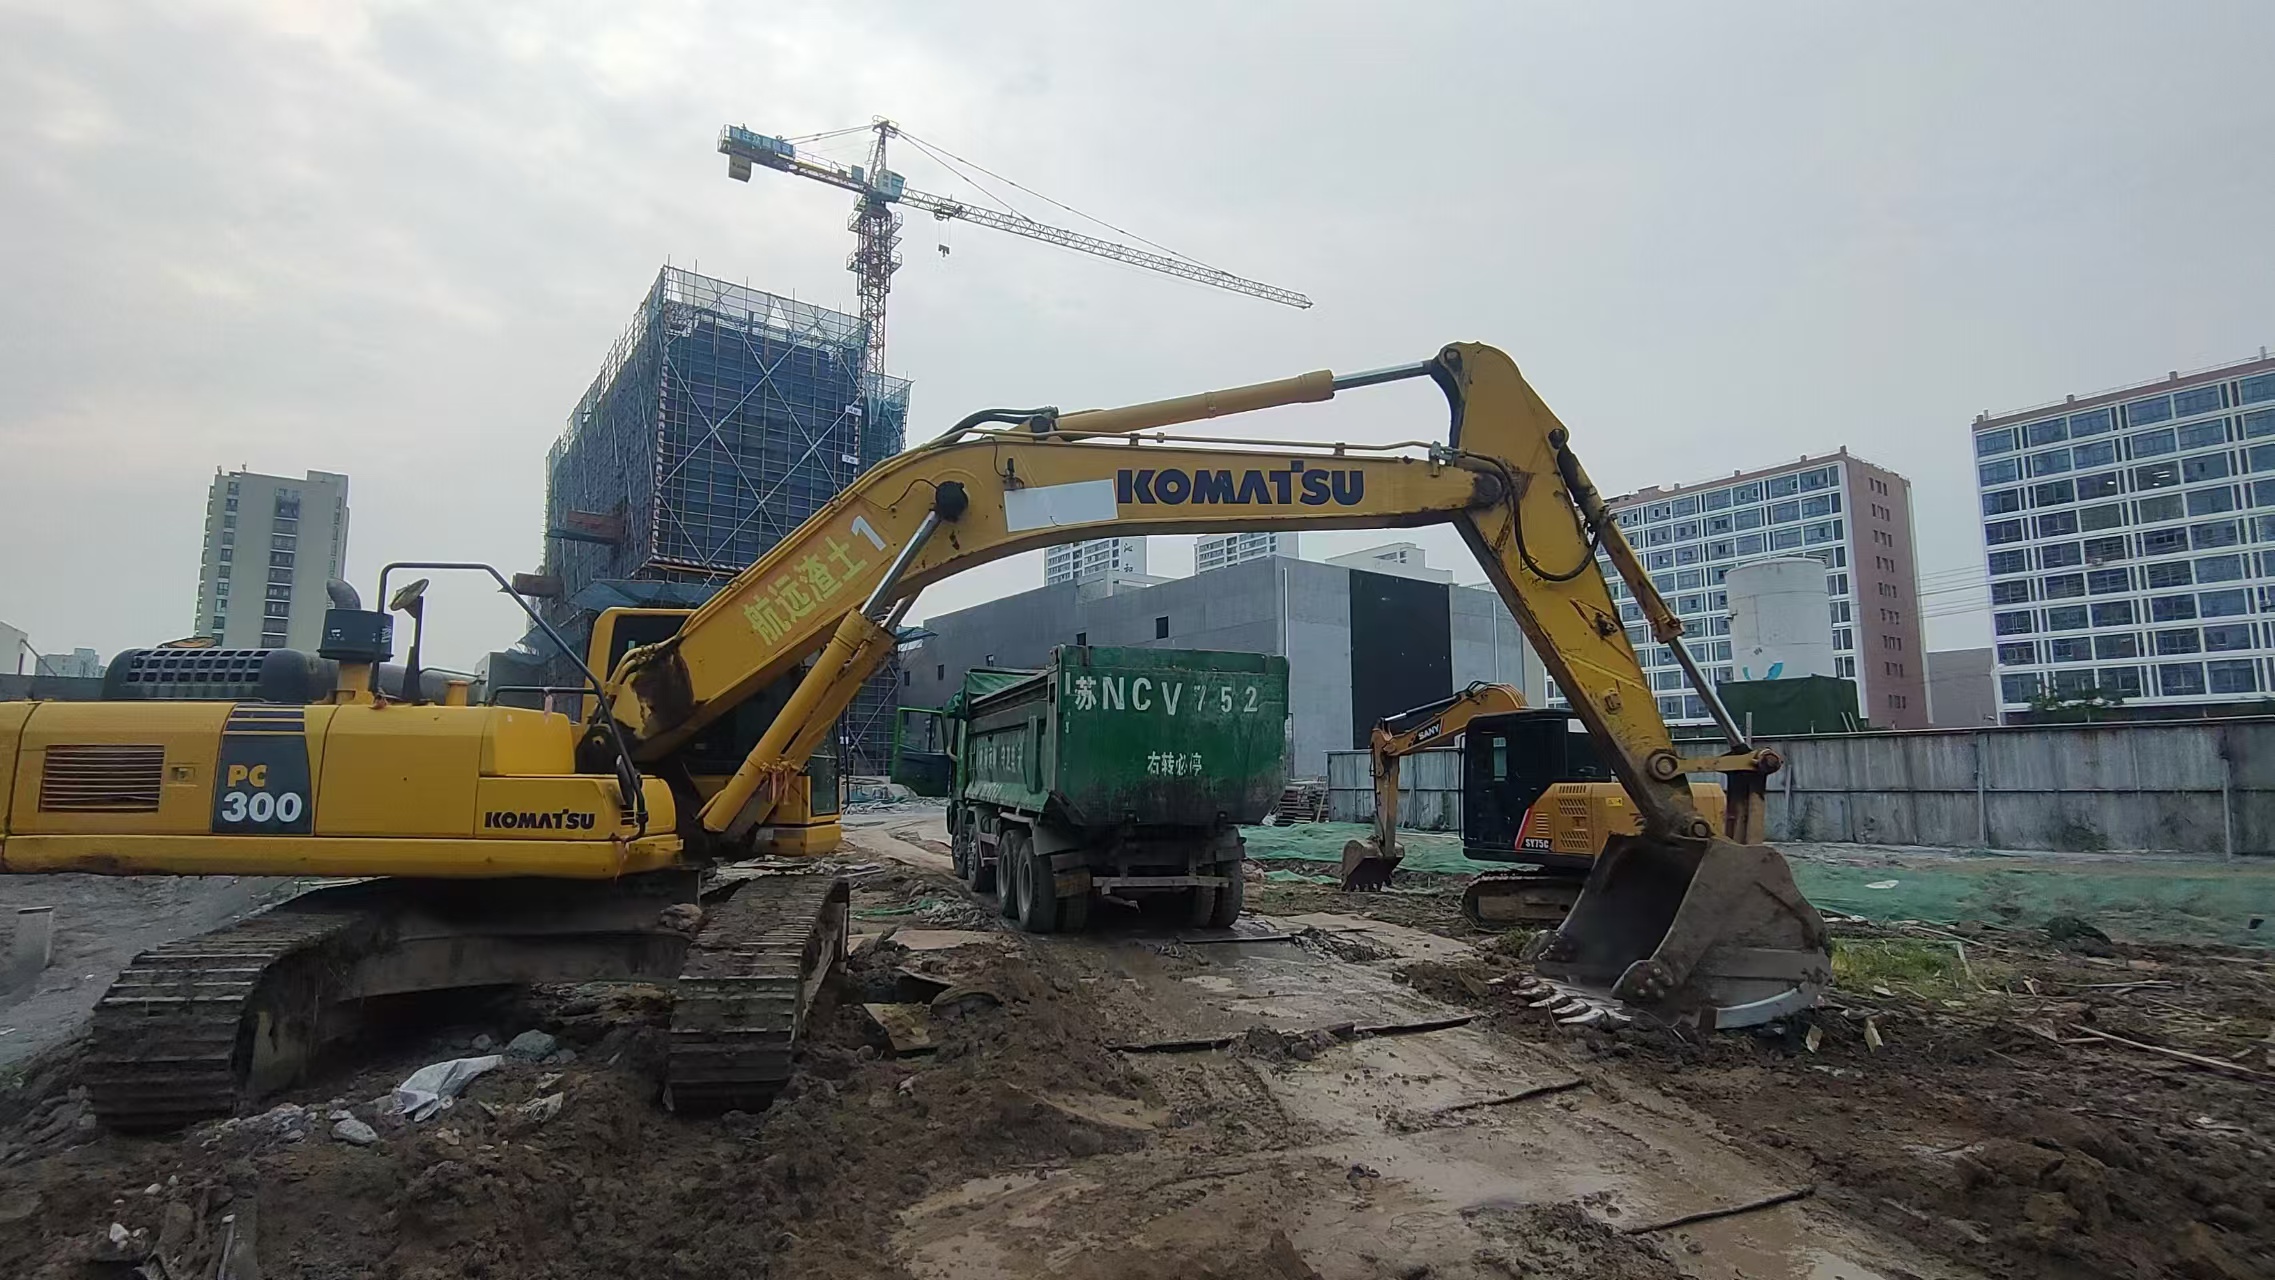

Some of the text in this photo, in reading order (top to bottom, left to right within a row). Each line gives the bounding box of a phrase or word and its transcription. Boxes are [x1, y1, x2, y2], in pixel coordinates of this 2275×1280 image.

[1117, 460, 1364, 506] KOMATSU
[1418, 723, 1440, 740] SANY
[1147, 751, 1202, 776] 右转必停
[227, 764, 268, 788] PC
[221, 791, 302, 822] 300
[484, 808, 595, 830] KOMATSU
[1525, 839, 1549, 848] SY75C
